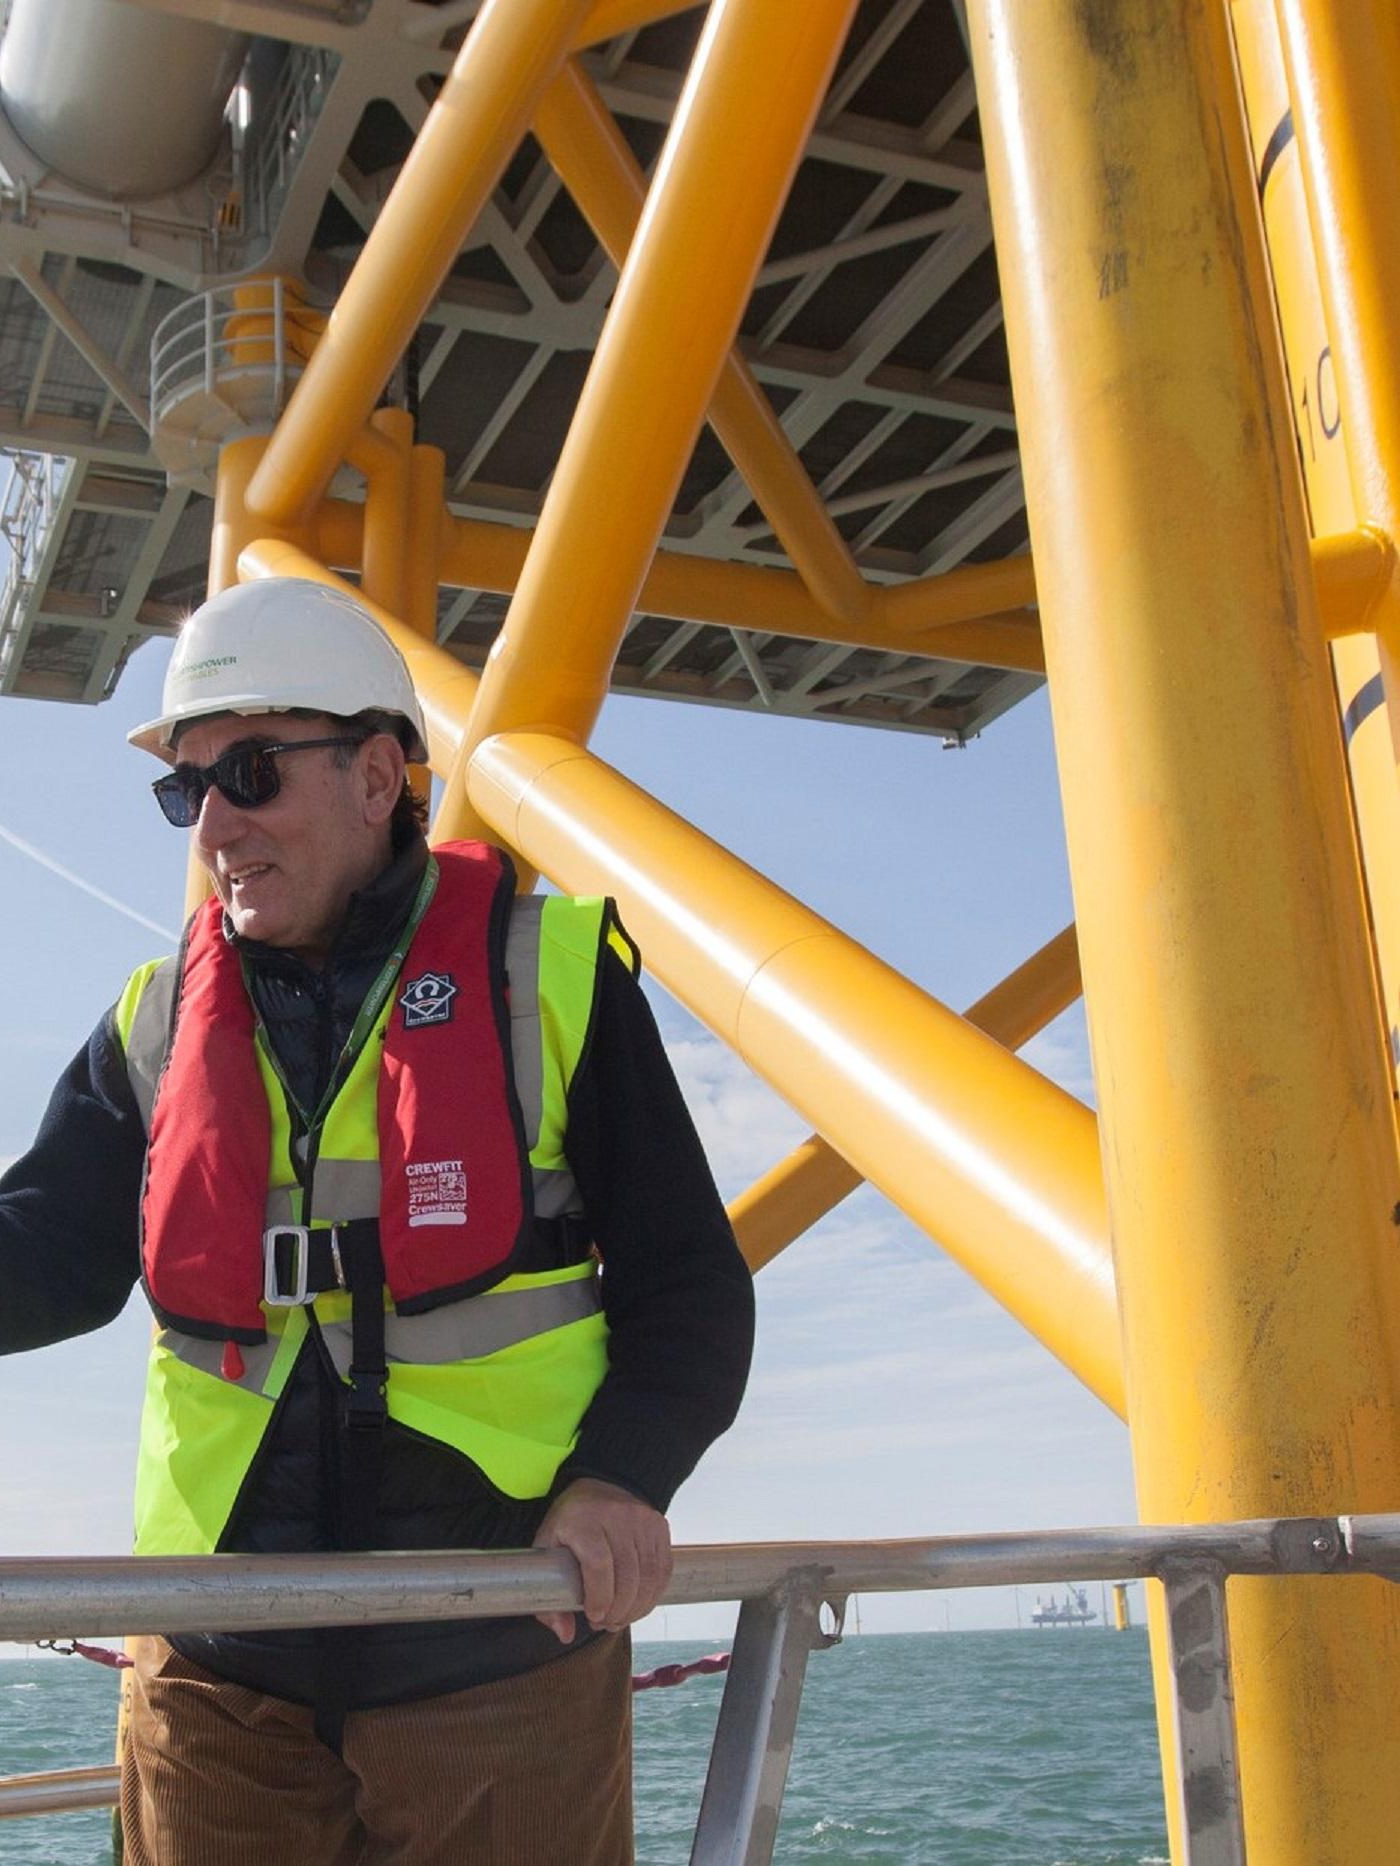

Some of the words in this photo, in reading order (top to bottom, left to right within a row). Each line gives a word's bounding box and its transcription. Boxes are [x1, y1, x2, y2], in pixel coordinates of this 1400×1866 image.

[406, 1161, 463, 1176] CREWFIT
[409, 1191, 438, 1204] 275N
[408, 1203, 467, 1215] Crewsaver
